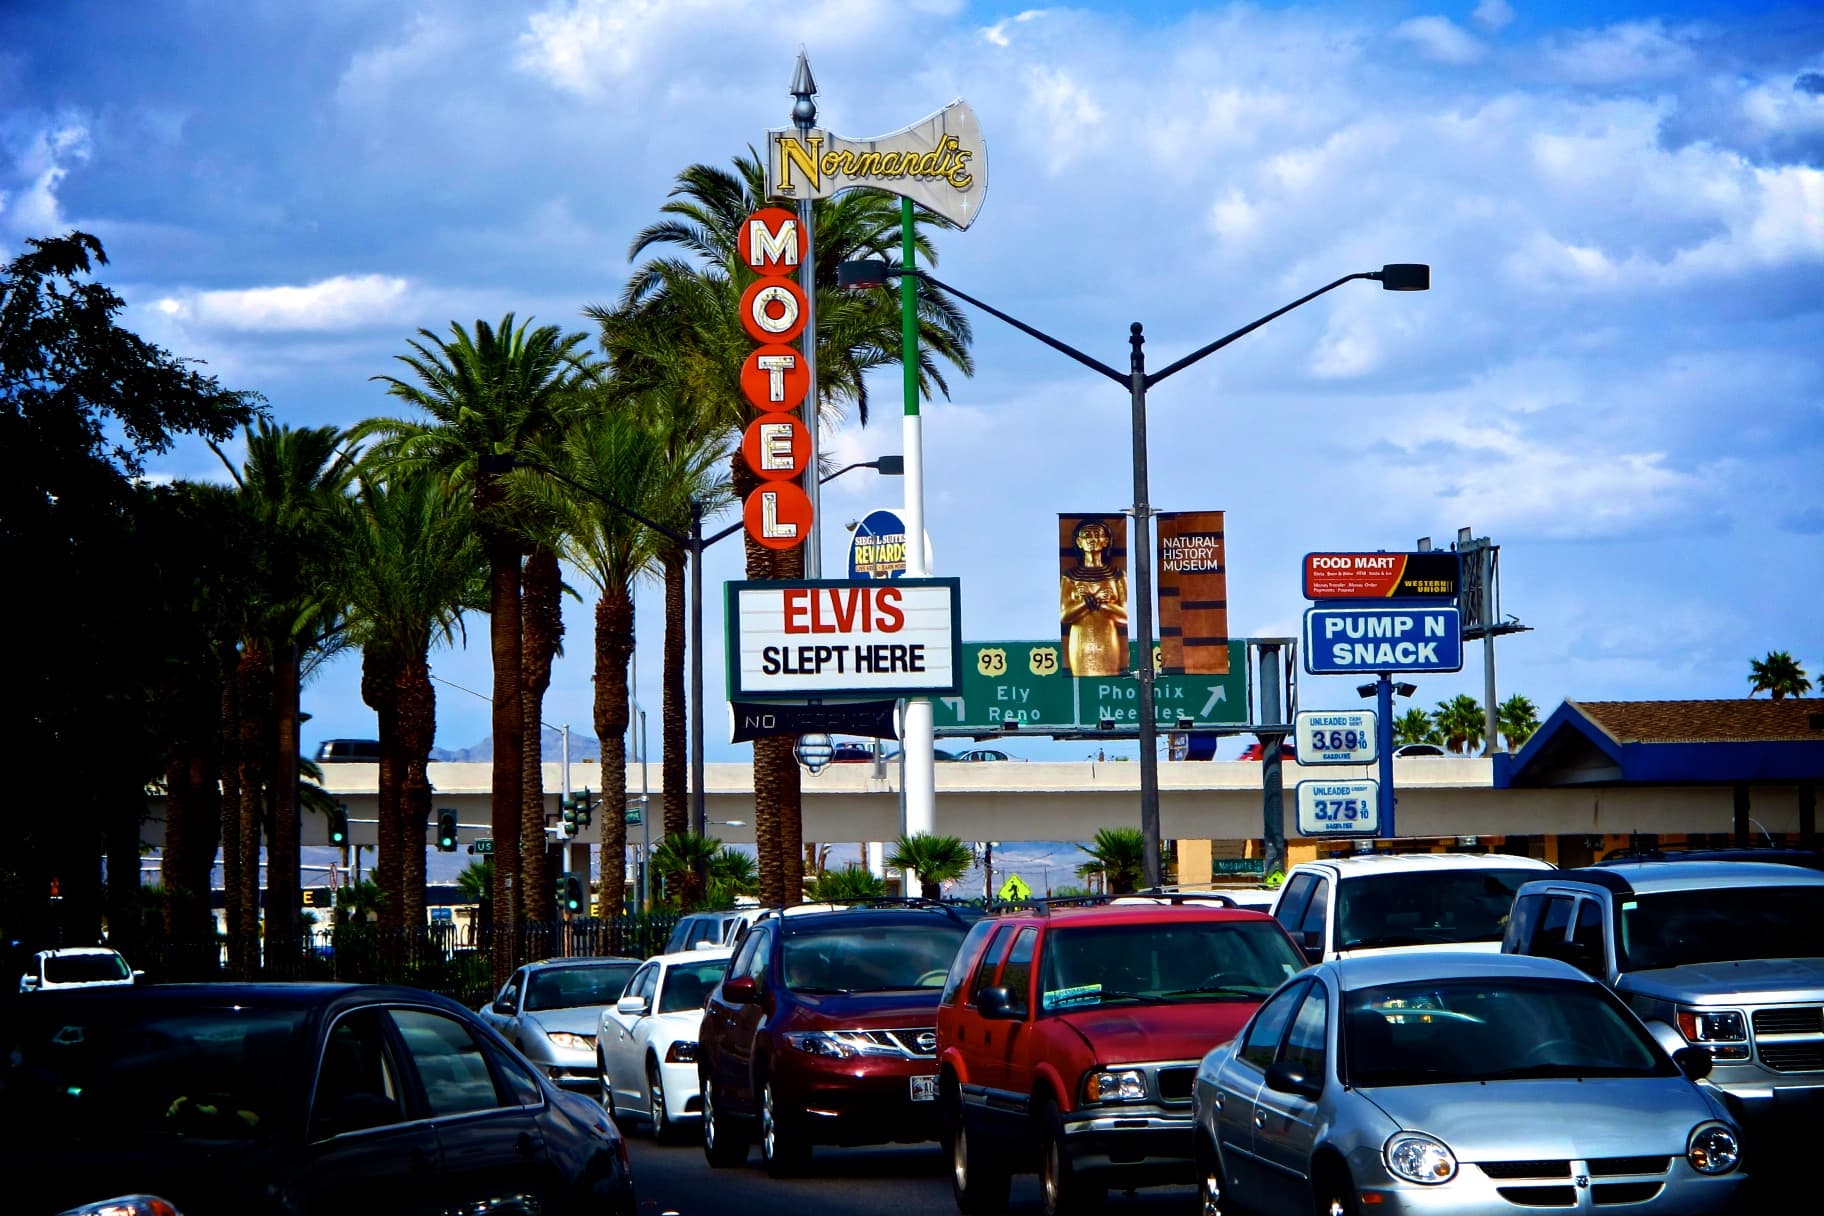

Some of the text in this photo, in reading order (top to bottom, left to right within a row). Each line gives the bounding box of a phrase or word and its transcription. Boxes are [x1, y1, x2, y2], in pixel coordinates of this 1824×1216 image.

[775, 133, 973, 193] Normandie
[749, 219, 798, 538] MOTEL
[855, 535, 882, 546] SIEGL
[1163, 536, 1219, 548] NATURAL
[1163, 548, 1213, 560] HISTORY
[1163, 560, 1218, 571] MUSEUM
[1312, 557, 1396, 569] FOOD MART
[783, 586, 905, 634] ELVIS
[1325, 615, 1445, 639] PUMP N
[762, 644, 925, 675] SLEPT HERE
[981, 653, 1004, 670] 93
[1032, 653, 1055, 669] 95
[1332, 642, 1439, 665] SNACK
[997, 685, 1030, 703] Ely
[1098, 684, 1185, 700] Phonix
[989, 706, 1042, 722] Reno
[1099, 706, 1186, 720] Neeles
[745, 714, 776, 729] NO
[1310, 717, 1347, 726] UNLEADED
[1312, 730, 1358, 750] 3.69
[1313, 786, 1350, 796] UNLEADED
[1314, 800, 1358, 821] 3.75
[477, 842, 492, 851] US
